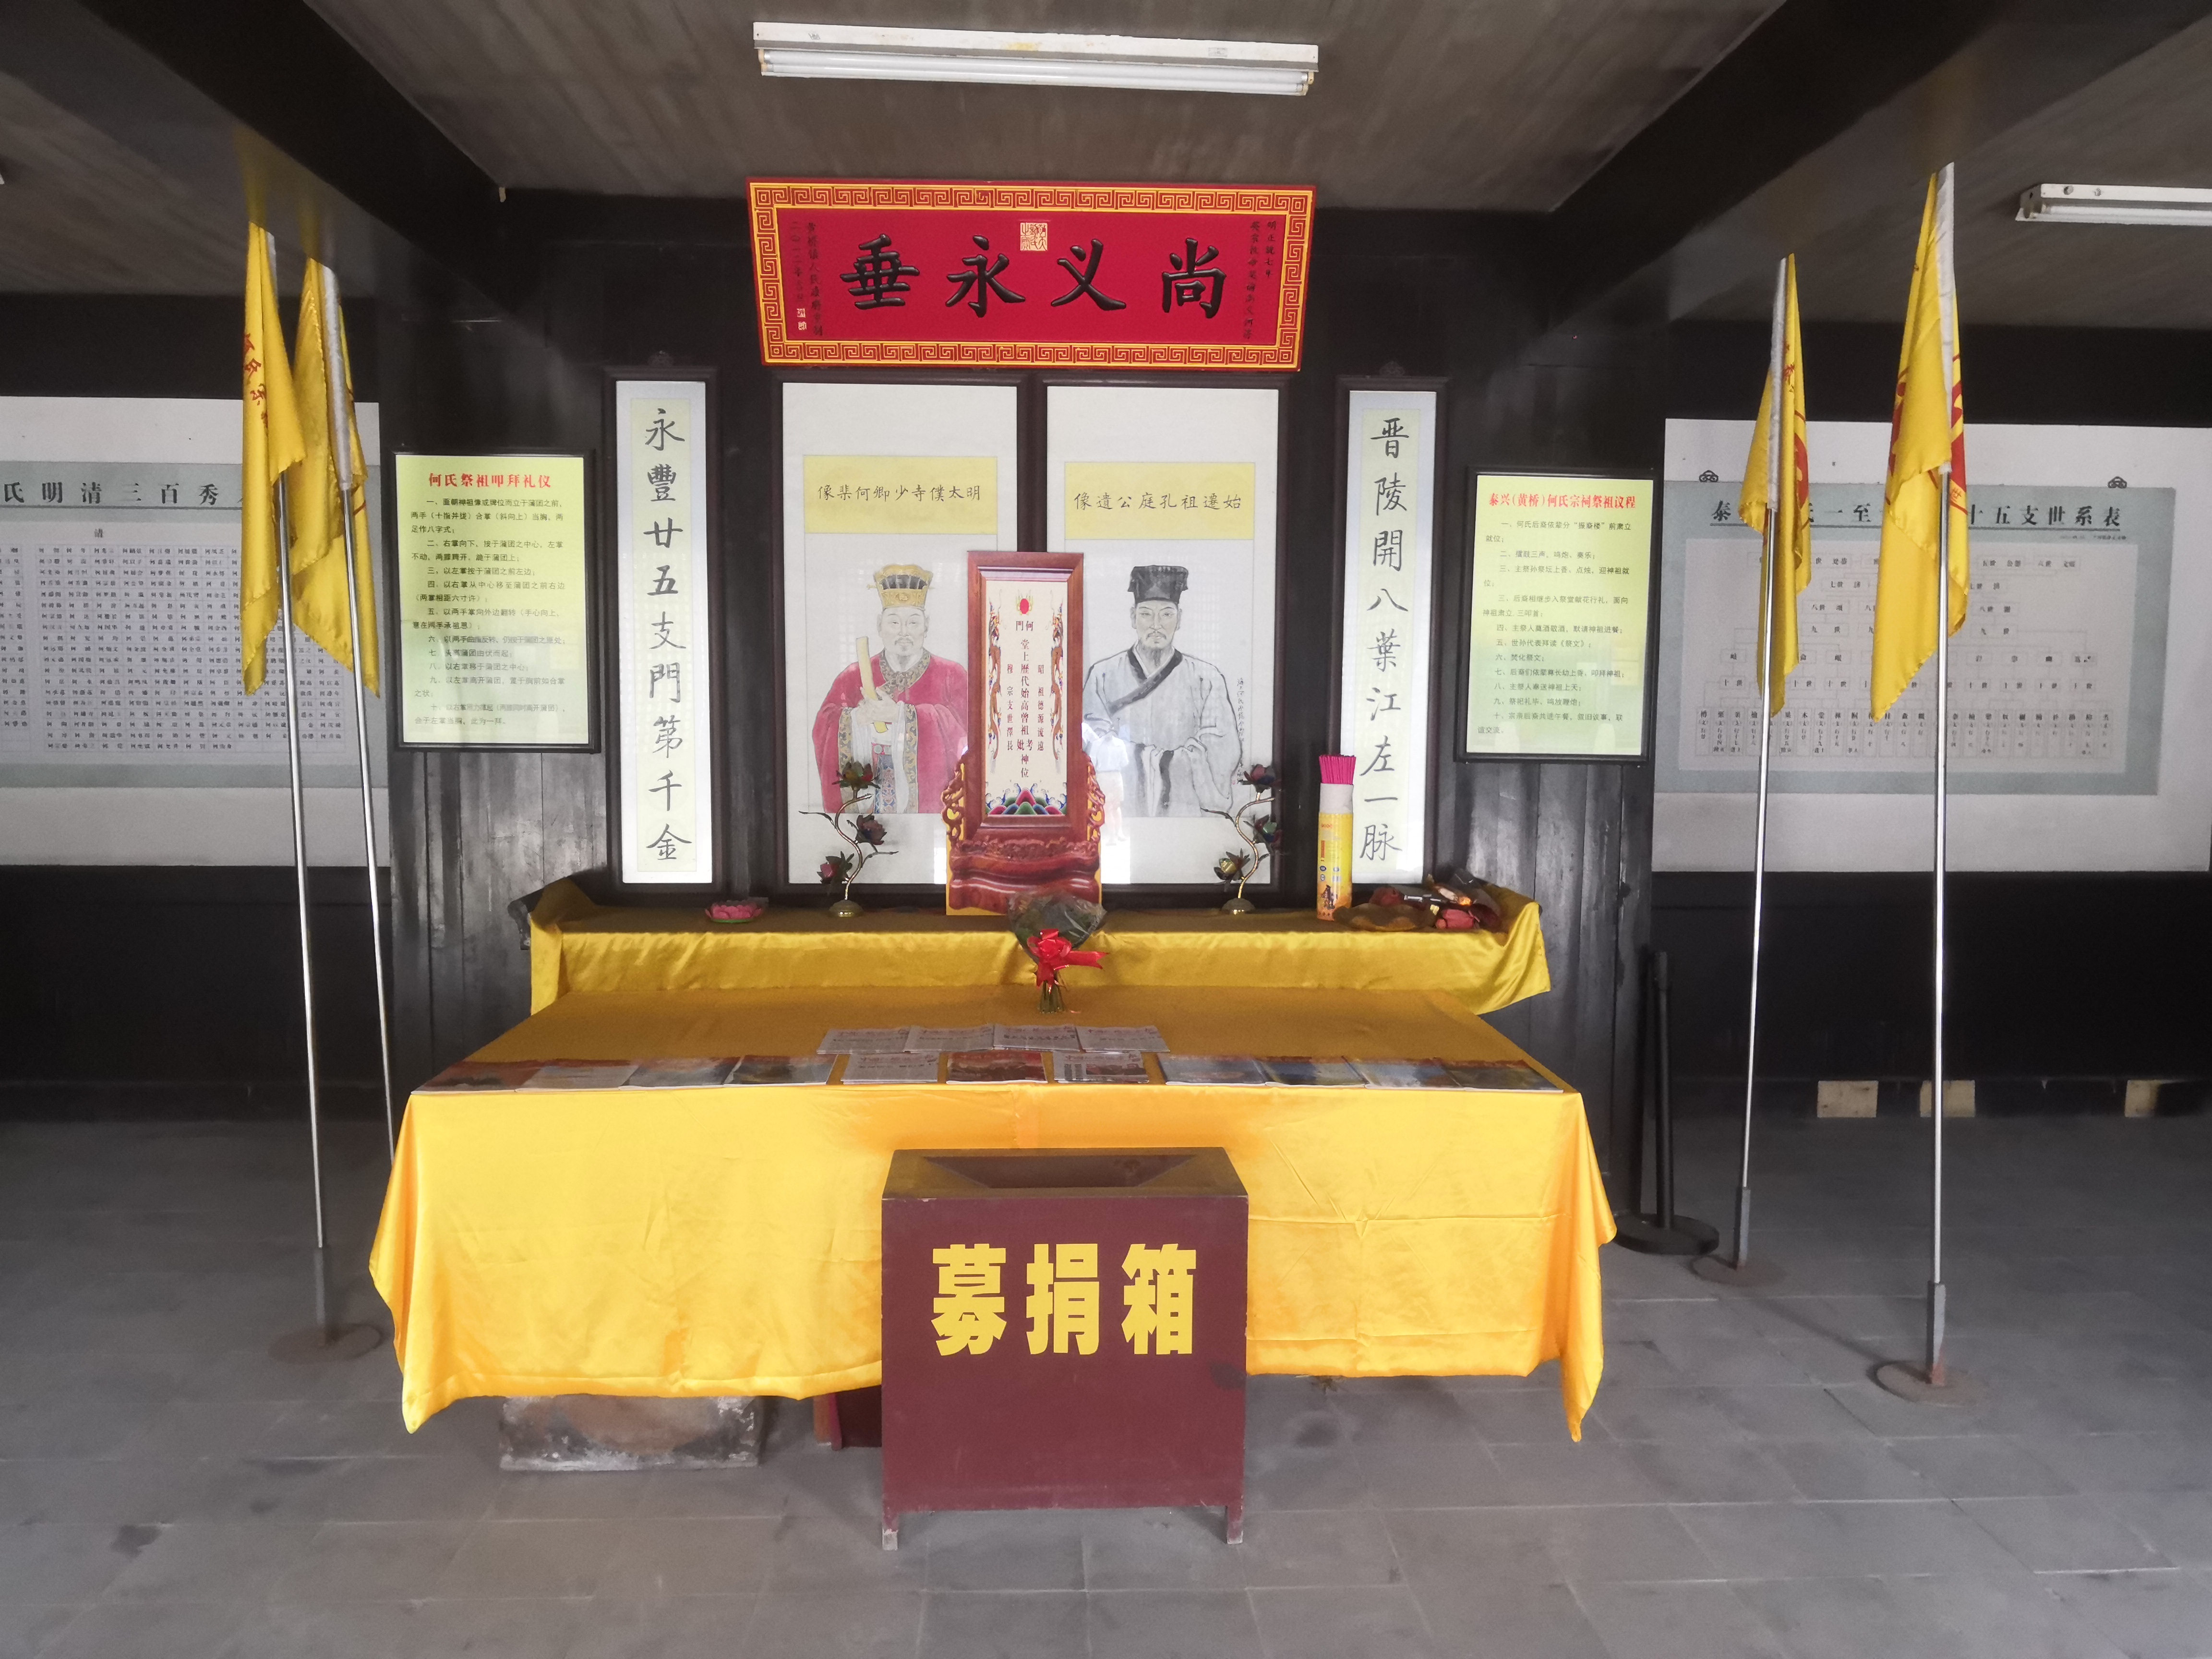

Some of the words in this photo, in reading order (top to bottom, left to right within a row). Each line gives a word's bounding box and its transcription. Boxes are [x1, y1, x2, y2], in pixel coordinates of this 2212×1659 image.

[840, 233, 1226, 319] 尚义永垂
[429, 472, 551, 488] 何氏祭祖叩拜礼仪
[643, 408, 693, 861] 永豐廿五支門第千金
[931, 1243, 1197, 1356] 募捐箱
